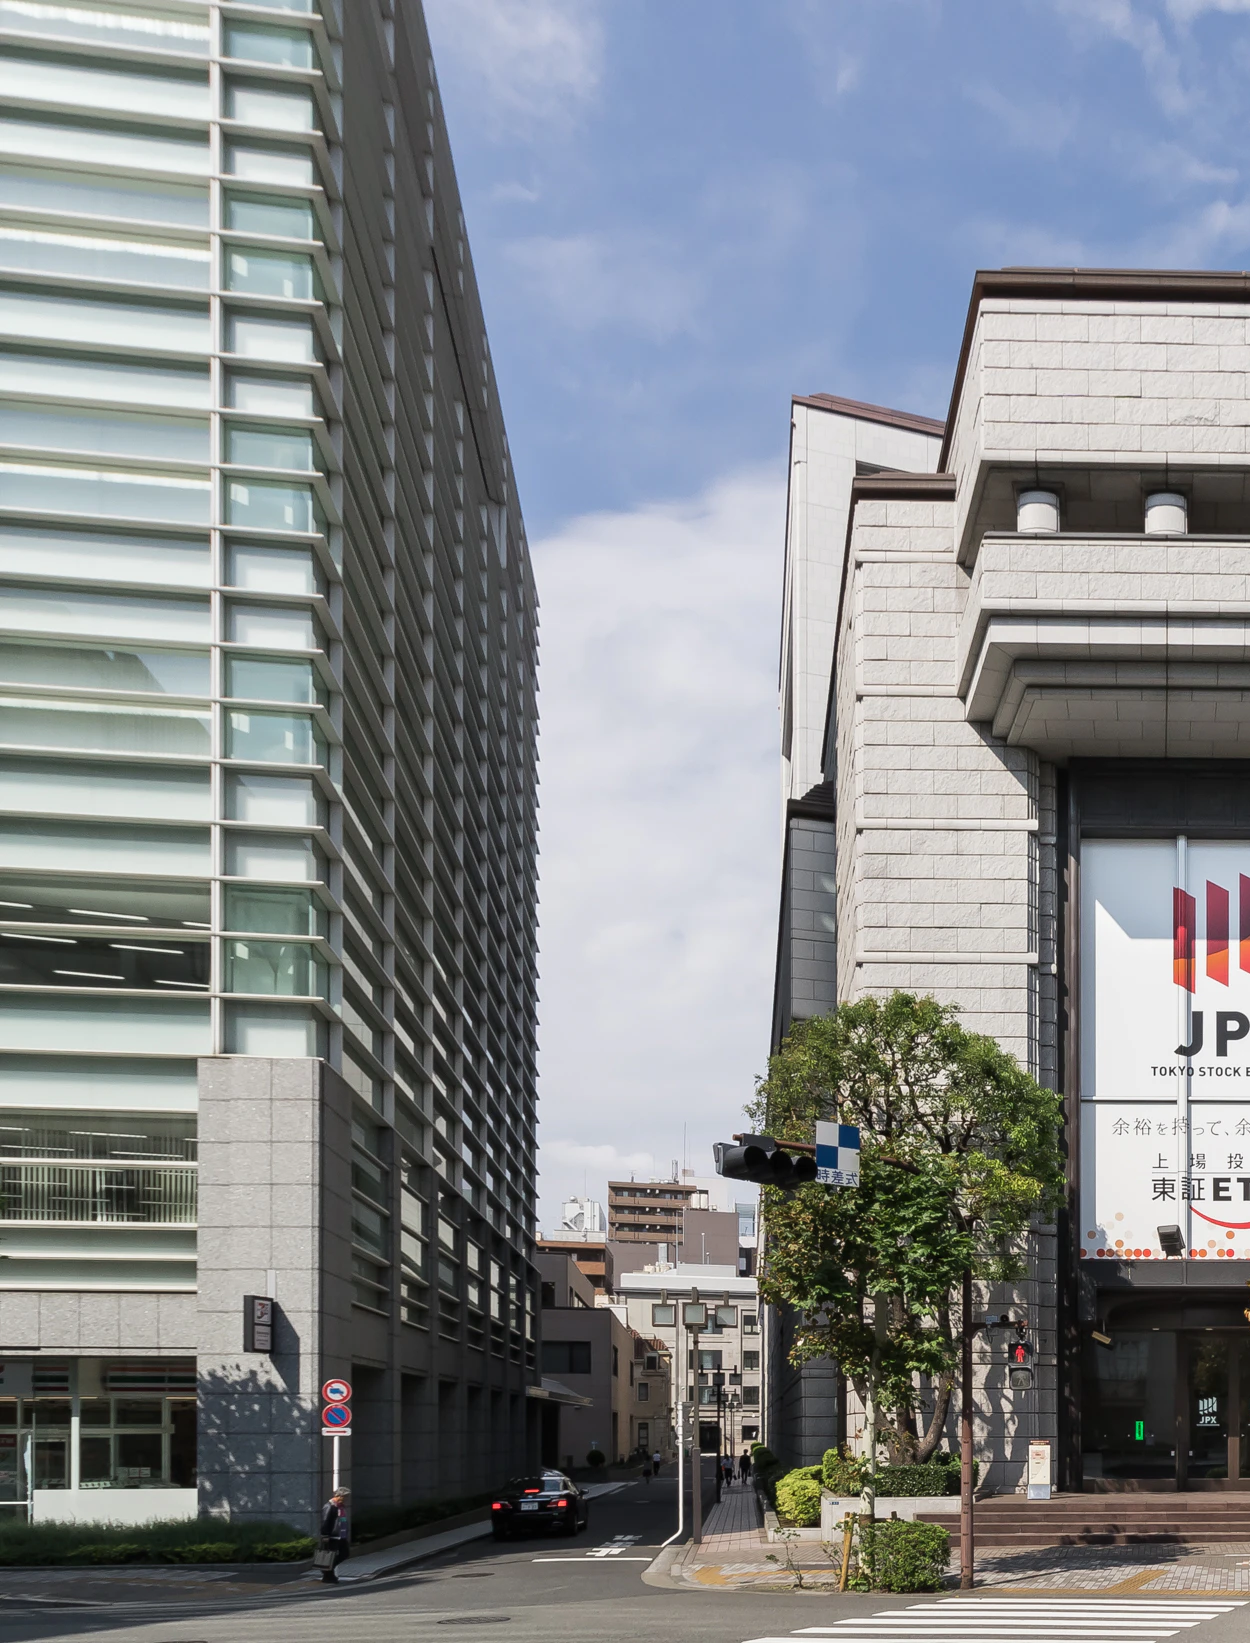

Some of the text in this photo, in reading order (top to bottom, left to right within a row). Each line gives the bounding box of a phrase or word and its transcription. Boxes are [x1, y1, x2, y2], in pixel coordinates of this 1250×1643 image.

[1151, 1066, 1194, 1077] TOKYO
[1199, 1066, 1241, 1077] STOCK
[816, 1169, 858, 1186] 時差式
[1199, 1416, 1217, 1424] JPX
